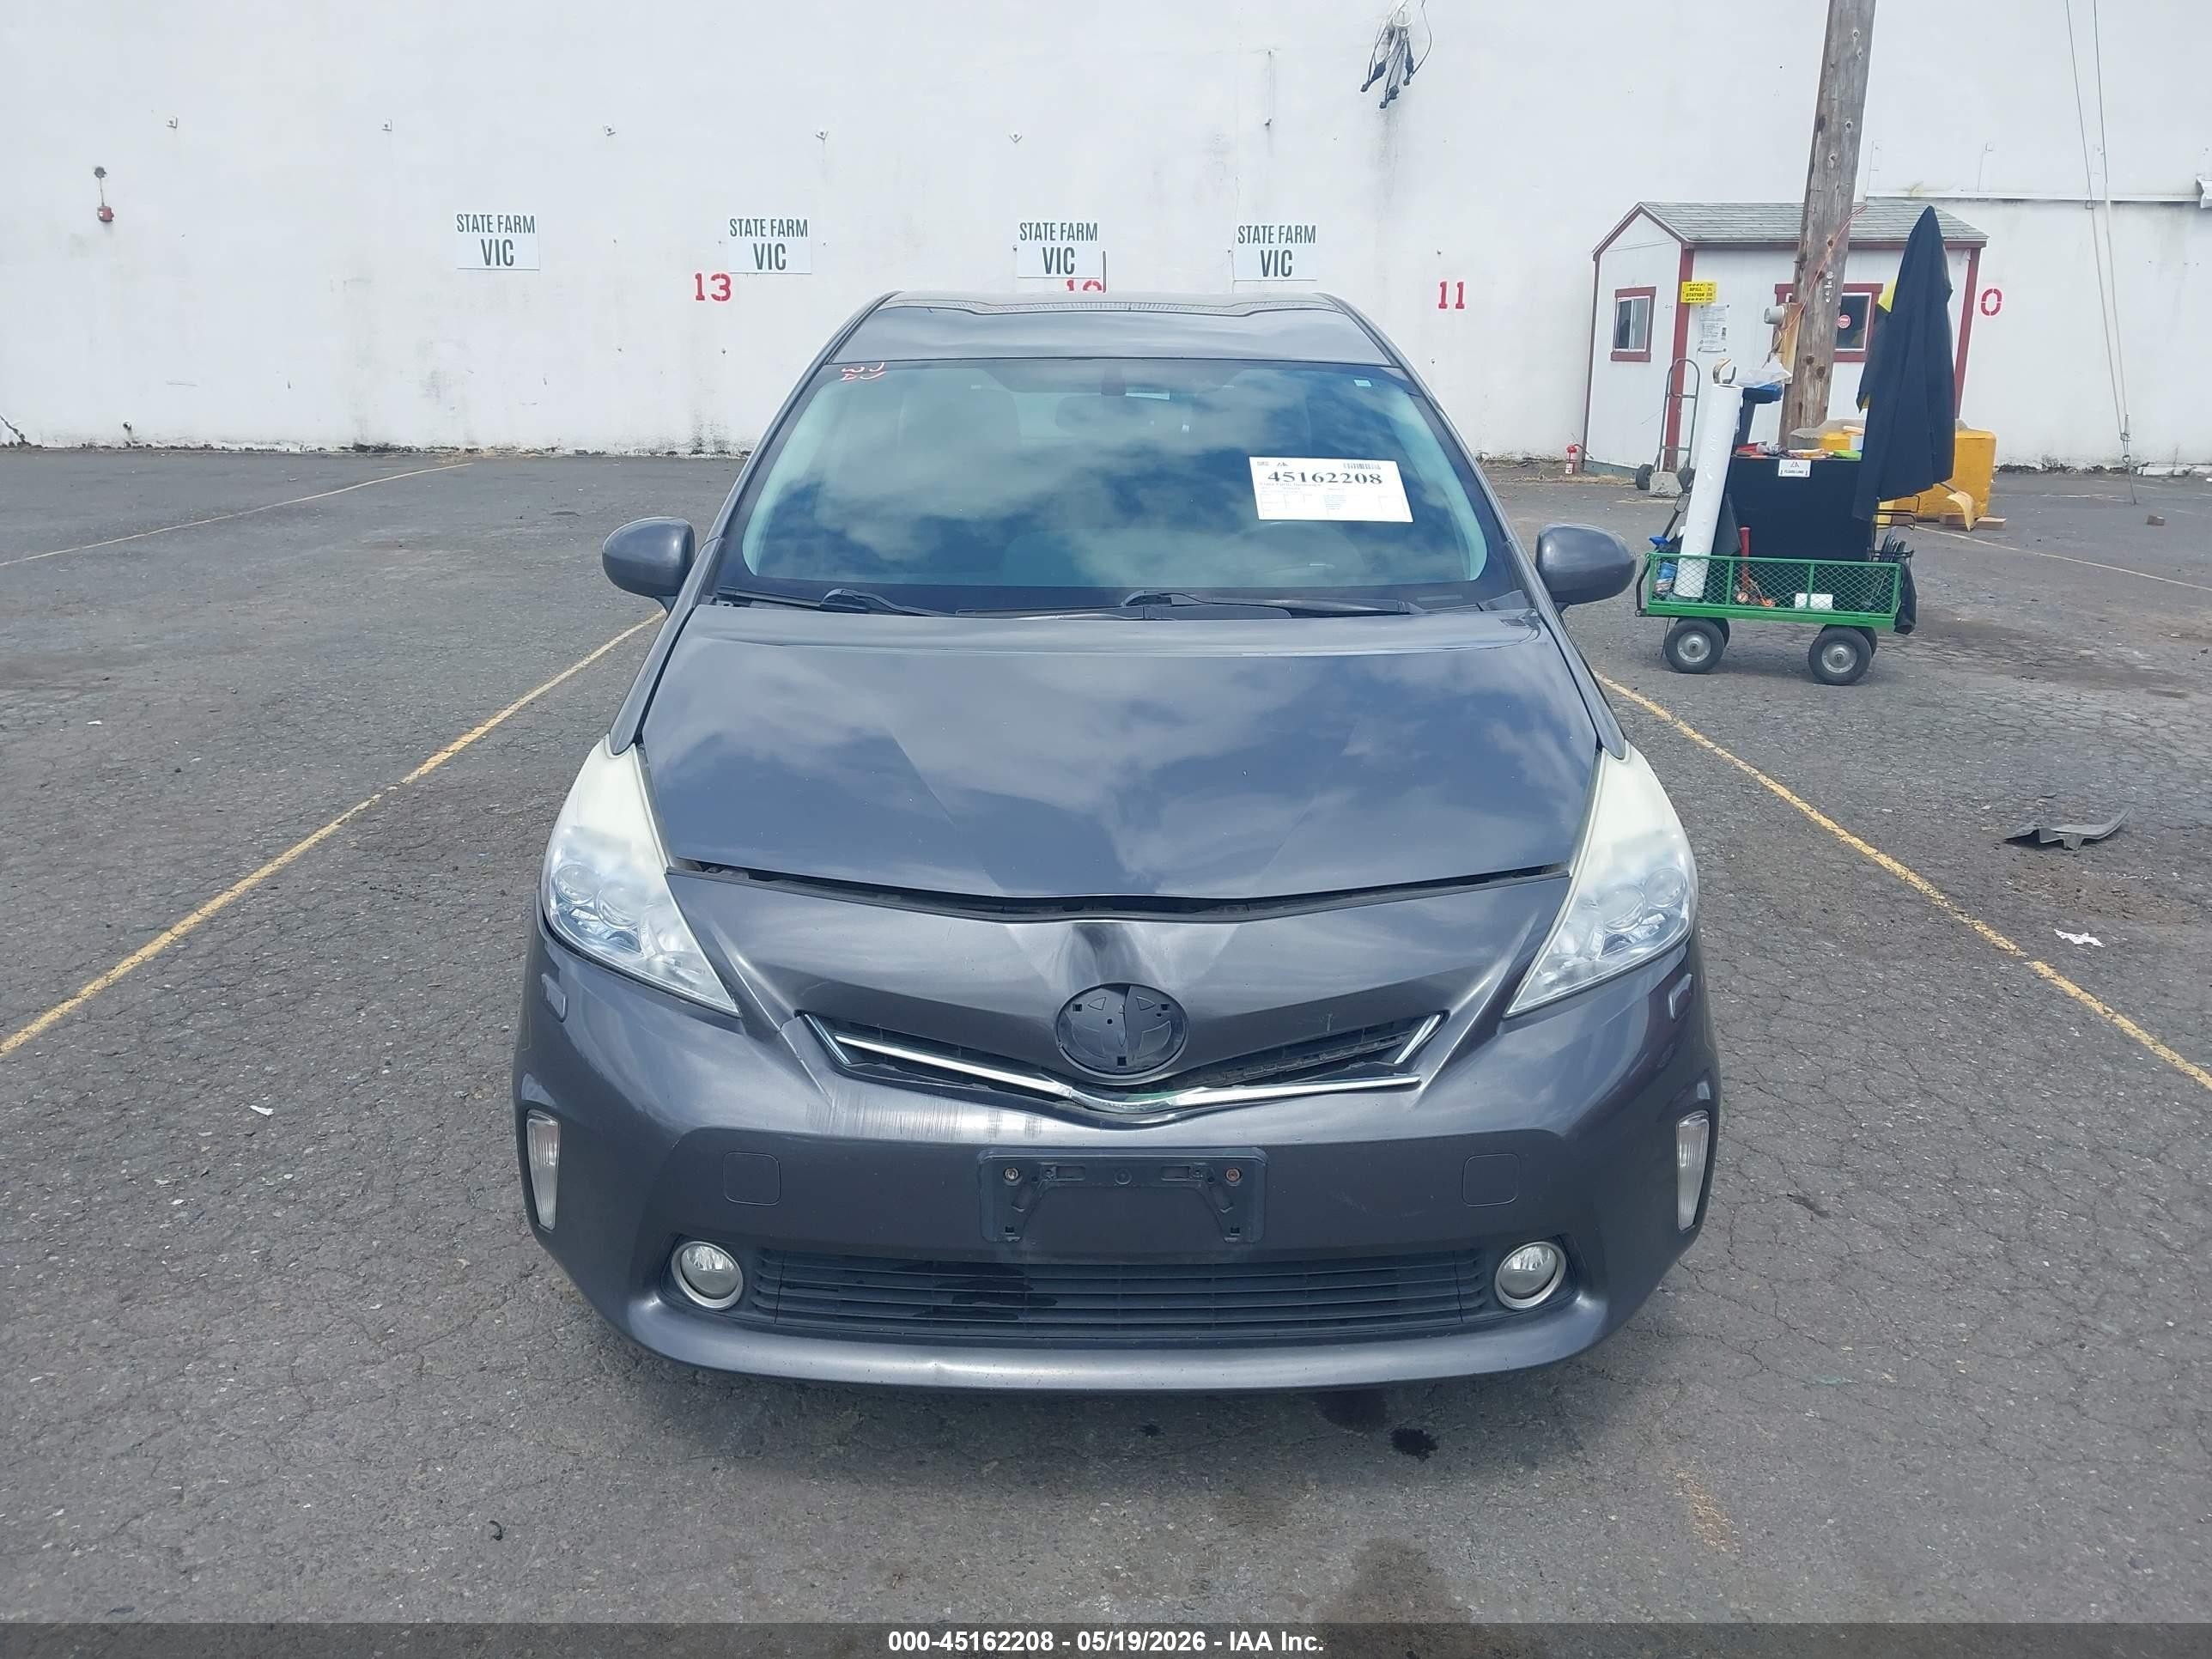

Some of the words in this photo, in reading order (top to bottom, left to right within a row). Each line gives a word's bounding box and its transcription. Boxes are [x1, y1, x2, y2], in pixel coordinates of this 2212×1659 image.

[456, 214, 494, 234] STATE
[497, 215, 535, 234] FARM
[729, 218, 767, 237] STATE
[770, 218, 808, 237] FARM
[1019, 222, 1056, 241] STATE
[1060, 222, 1098, 241] FARM
[1237, 225, 1274, 244] STATE
[1278, 225, 1316, 244] FARM
[480, 239, 514, 267] VIC
[753, 243, 787, 270] VIC
[1042, 246, 1075, 276] VIC
[1260, 249, 1292, 277] VIC
[695, 273, 732, 301] 13
[1437, 281, 1465, 310] 11
[1267, 471, 1383, 485] 45162208
